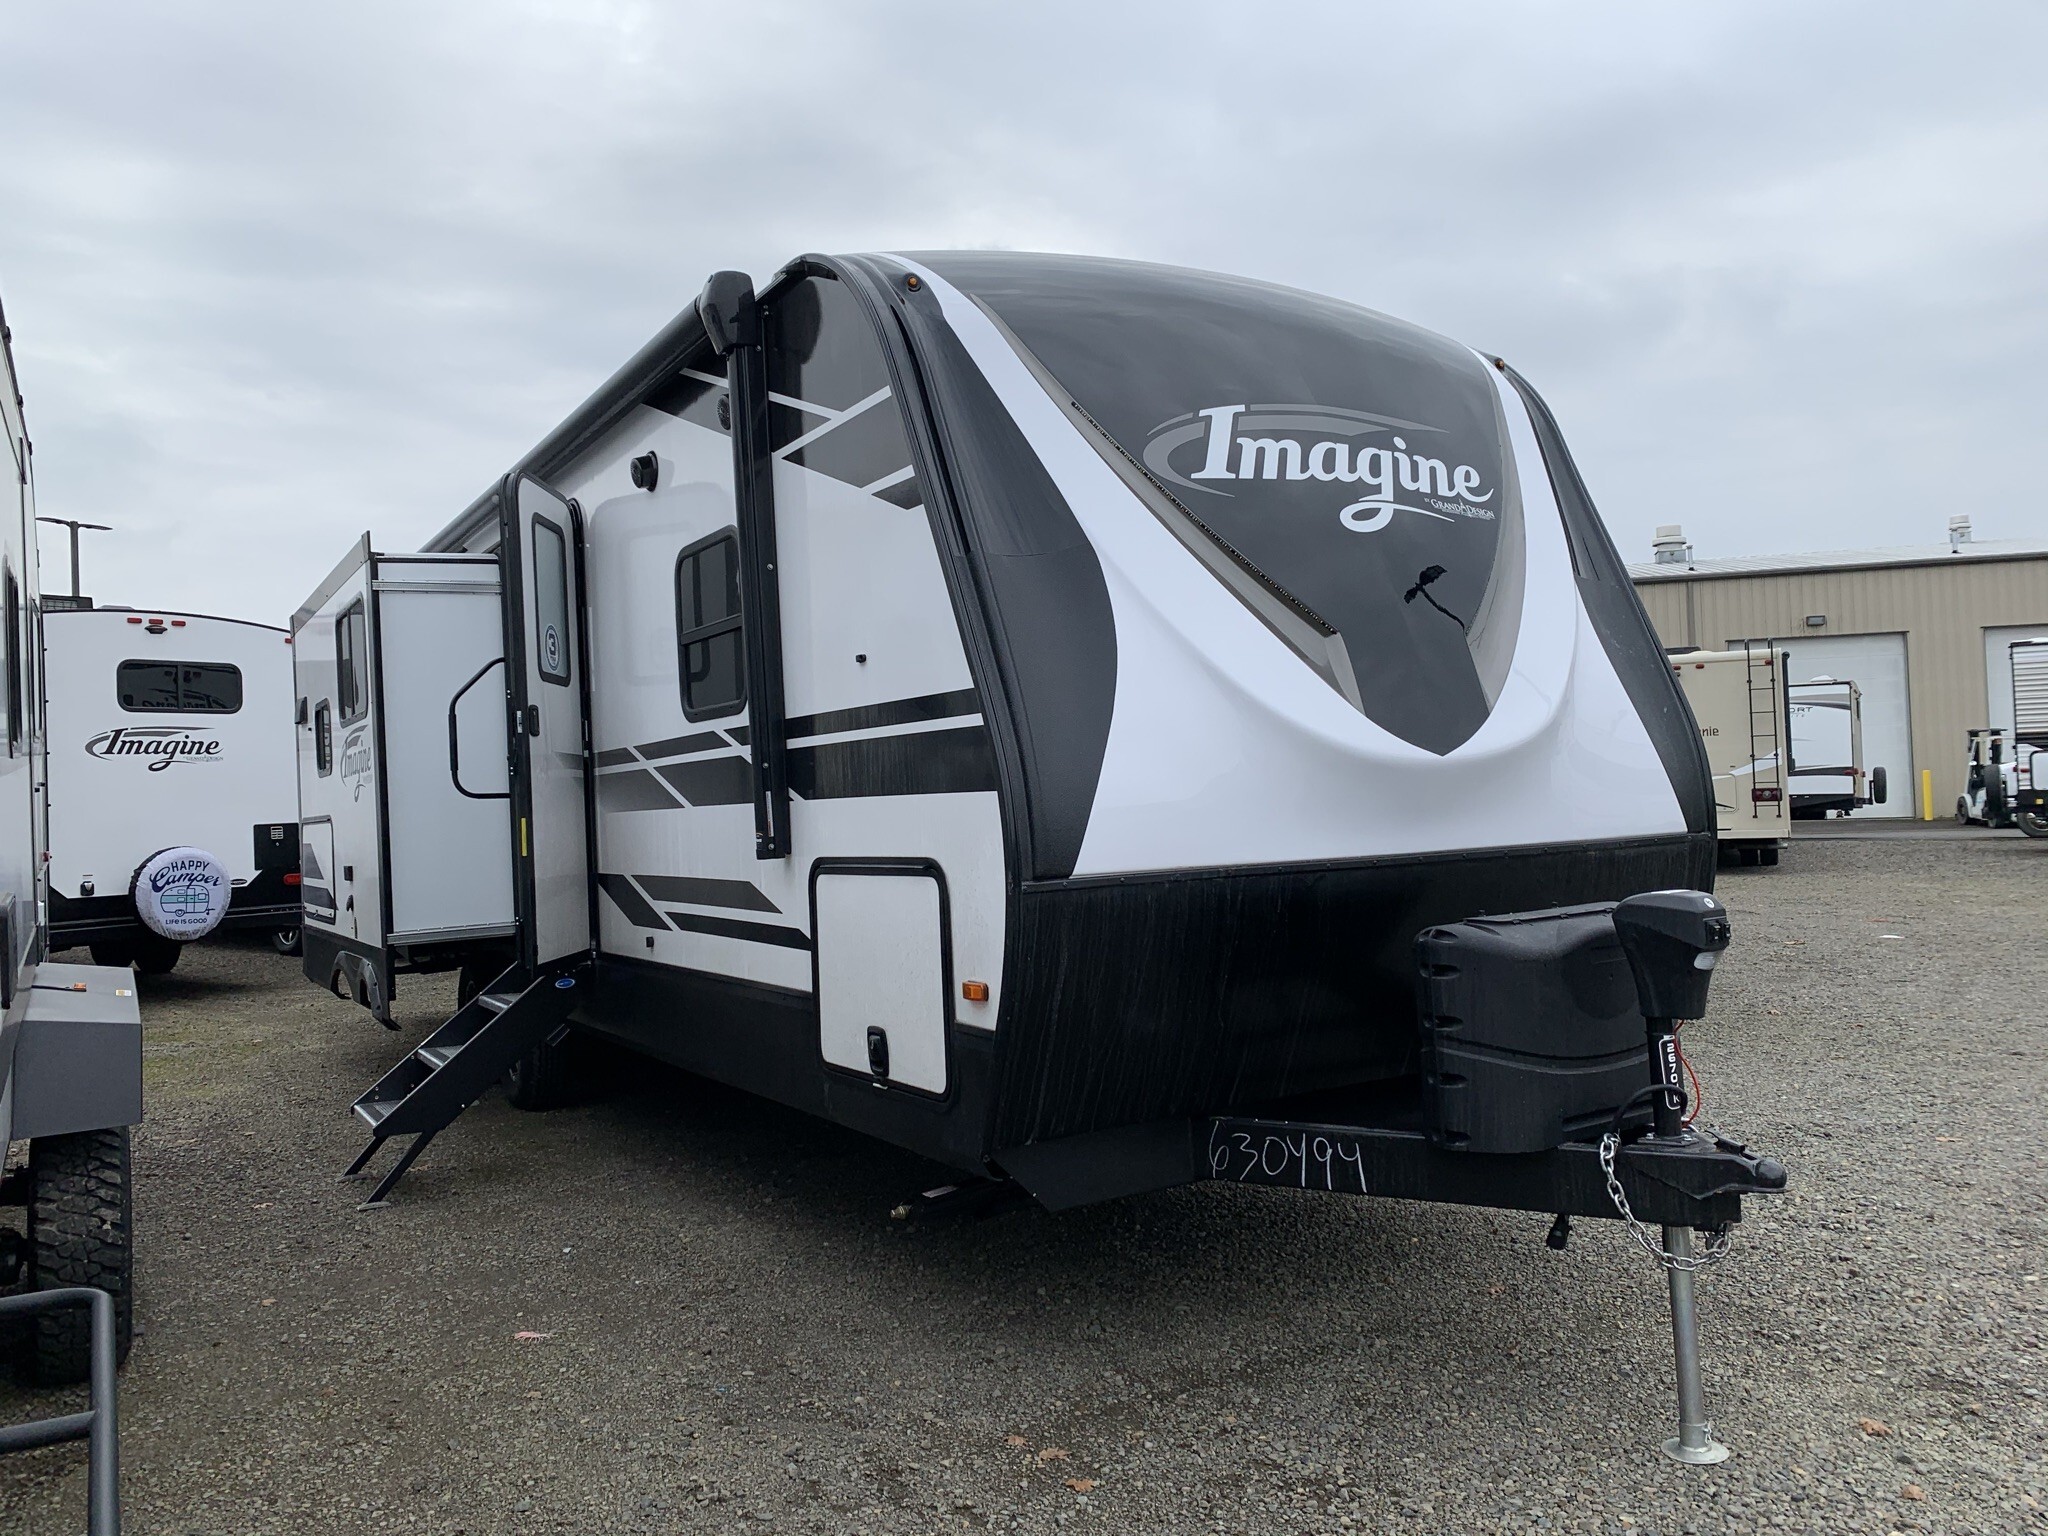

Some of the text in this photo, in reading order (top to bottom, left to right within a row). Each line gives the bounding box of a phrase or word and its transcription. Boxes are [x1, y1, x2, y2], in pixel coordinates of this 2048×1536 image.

[1190, 404, 1494, 533] Imagine
[1430, 499, 1461, 511] GRAND
[1466, 504, 1496, 519] DESIGN
[549, 632, 556, 656] 3
[99, 727, 224, 772] Imagine
[149, 866, 222, 893] Camper
[170, 860, 209, 873] HAPPY
[188, 917, 208, 925] GOOD
[1666, 1042, 1680, 1104] 2670K
[1208, 1120, 1368, 1194] 630494
